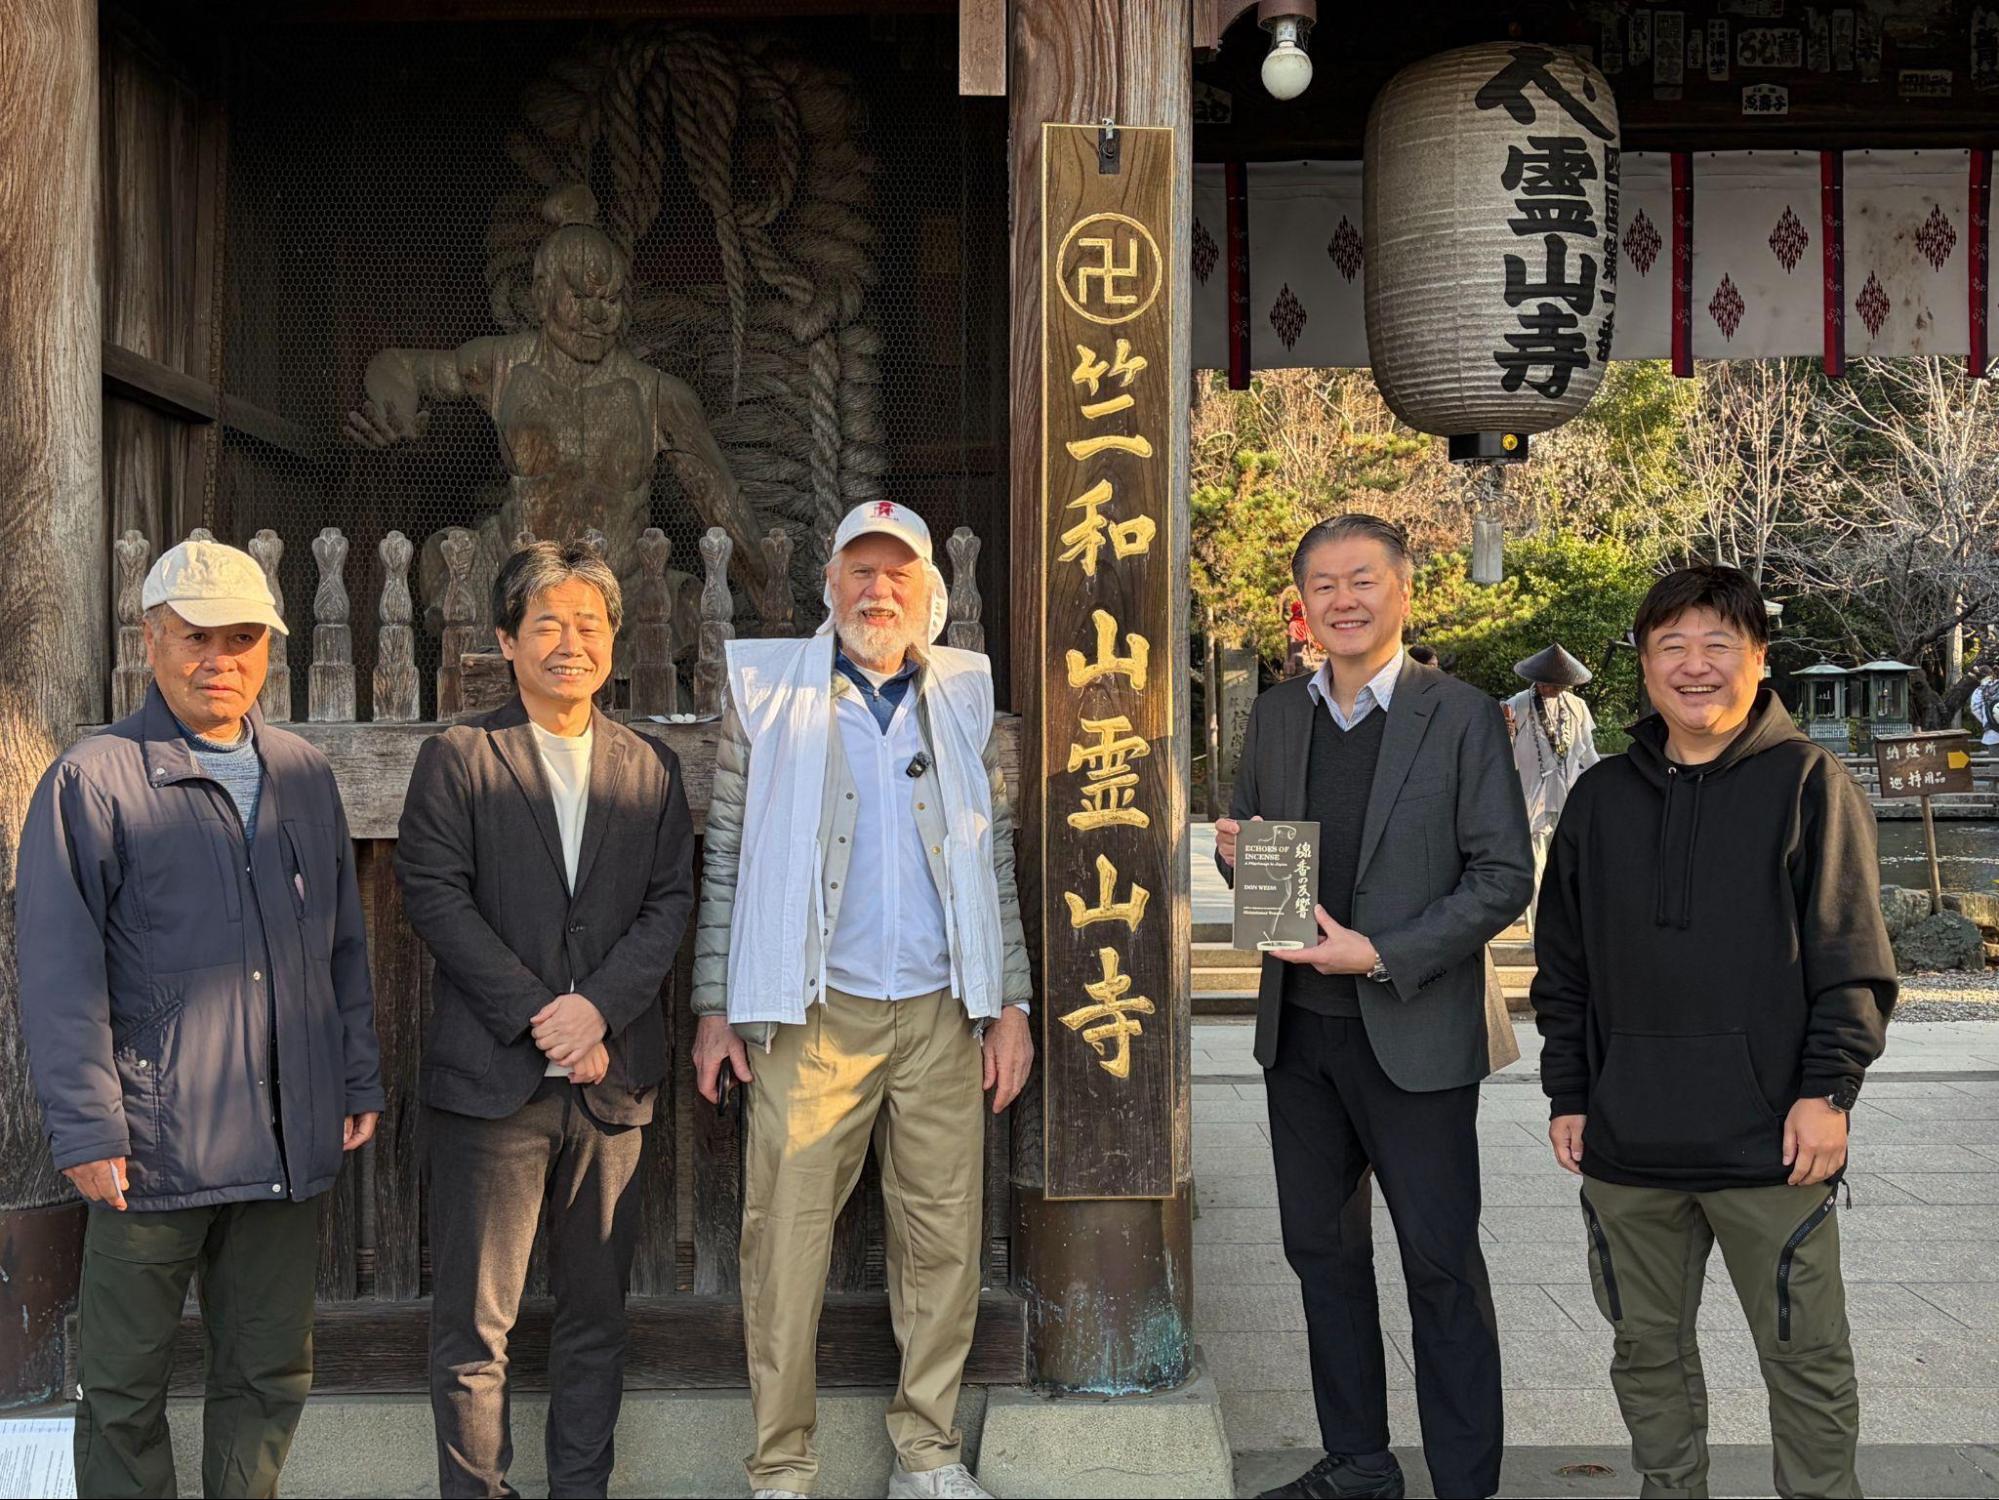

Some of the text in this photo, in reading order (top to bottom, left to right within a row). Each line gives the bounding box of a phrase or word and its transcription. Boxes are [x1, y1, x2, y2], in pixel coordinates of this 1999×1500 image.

[1057, 338, 1158, 1079] 竺和山霊山寺
[1886, 741, 1937, 760] 納経所
[1294, 842, 1312, 919] 線香の反響
